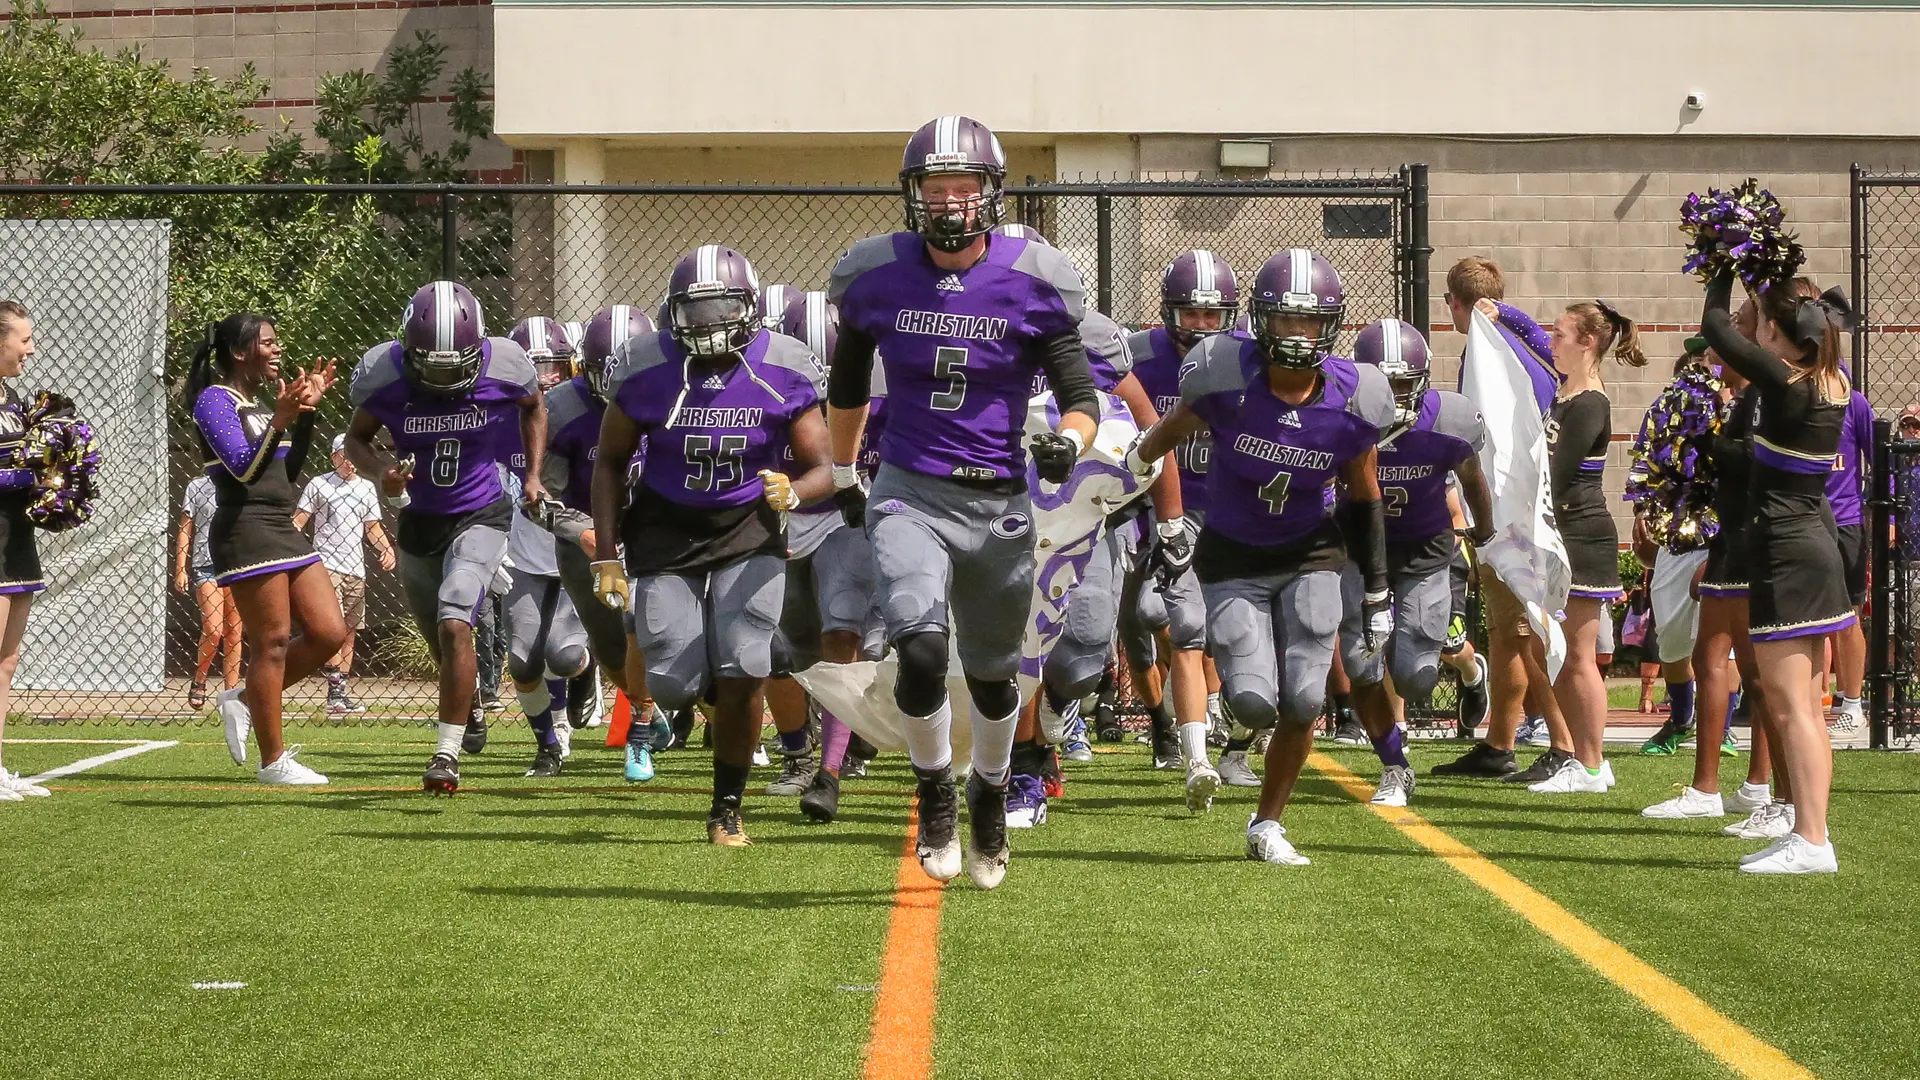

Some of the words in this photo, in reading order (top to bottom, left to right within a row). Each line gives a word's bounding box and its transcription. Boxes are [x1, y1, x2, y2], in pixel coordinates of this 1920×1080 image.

[936, 283, 965, 292] adidas
[895, 308, 1008, 340] CHRISTIAN
[930, 346, 969, 411] 5
[404, 410, 488, 434] CHRISTIAN
[431, 438, 461, 487] 8
[683, 435, 748, 492] 55
[1234, 433, 1334, 471] CHRISTIAN
[1376, 464, 1433, 481] ISTIAN
[1258, 471, 1292, 514] 4
[1383, 486, 1408, 517] 2
